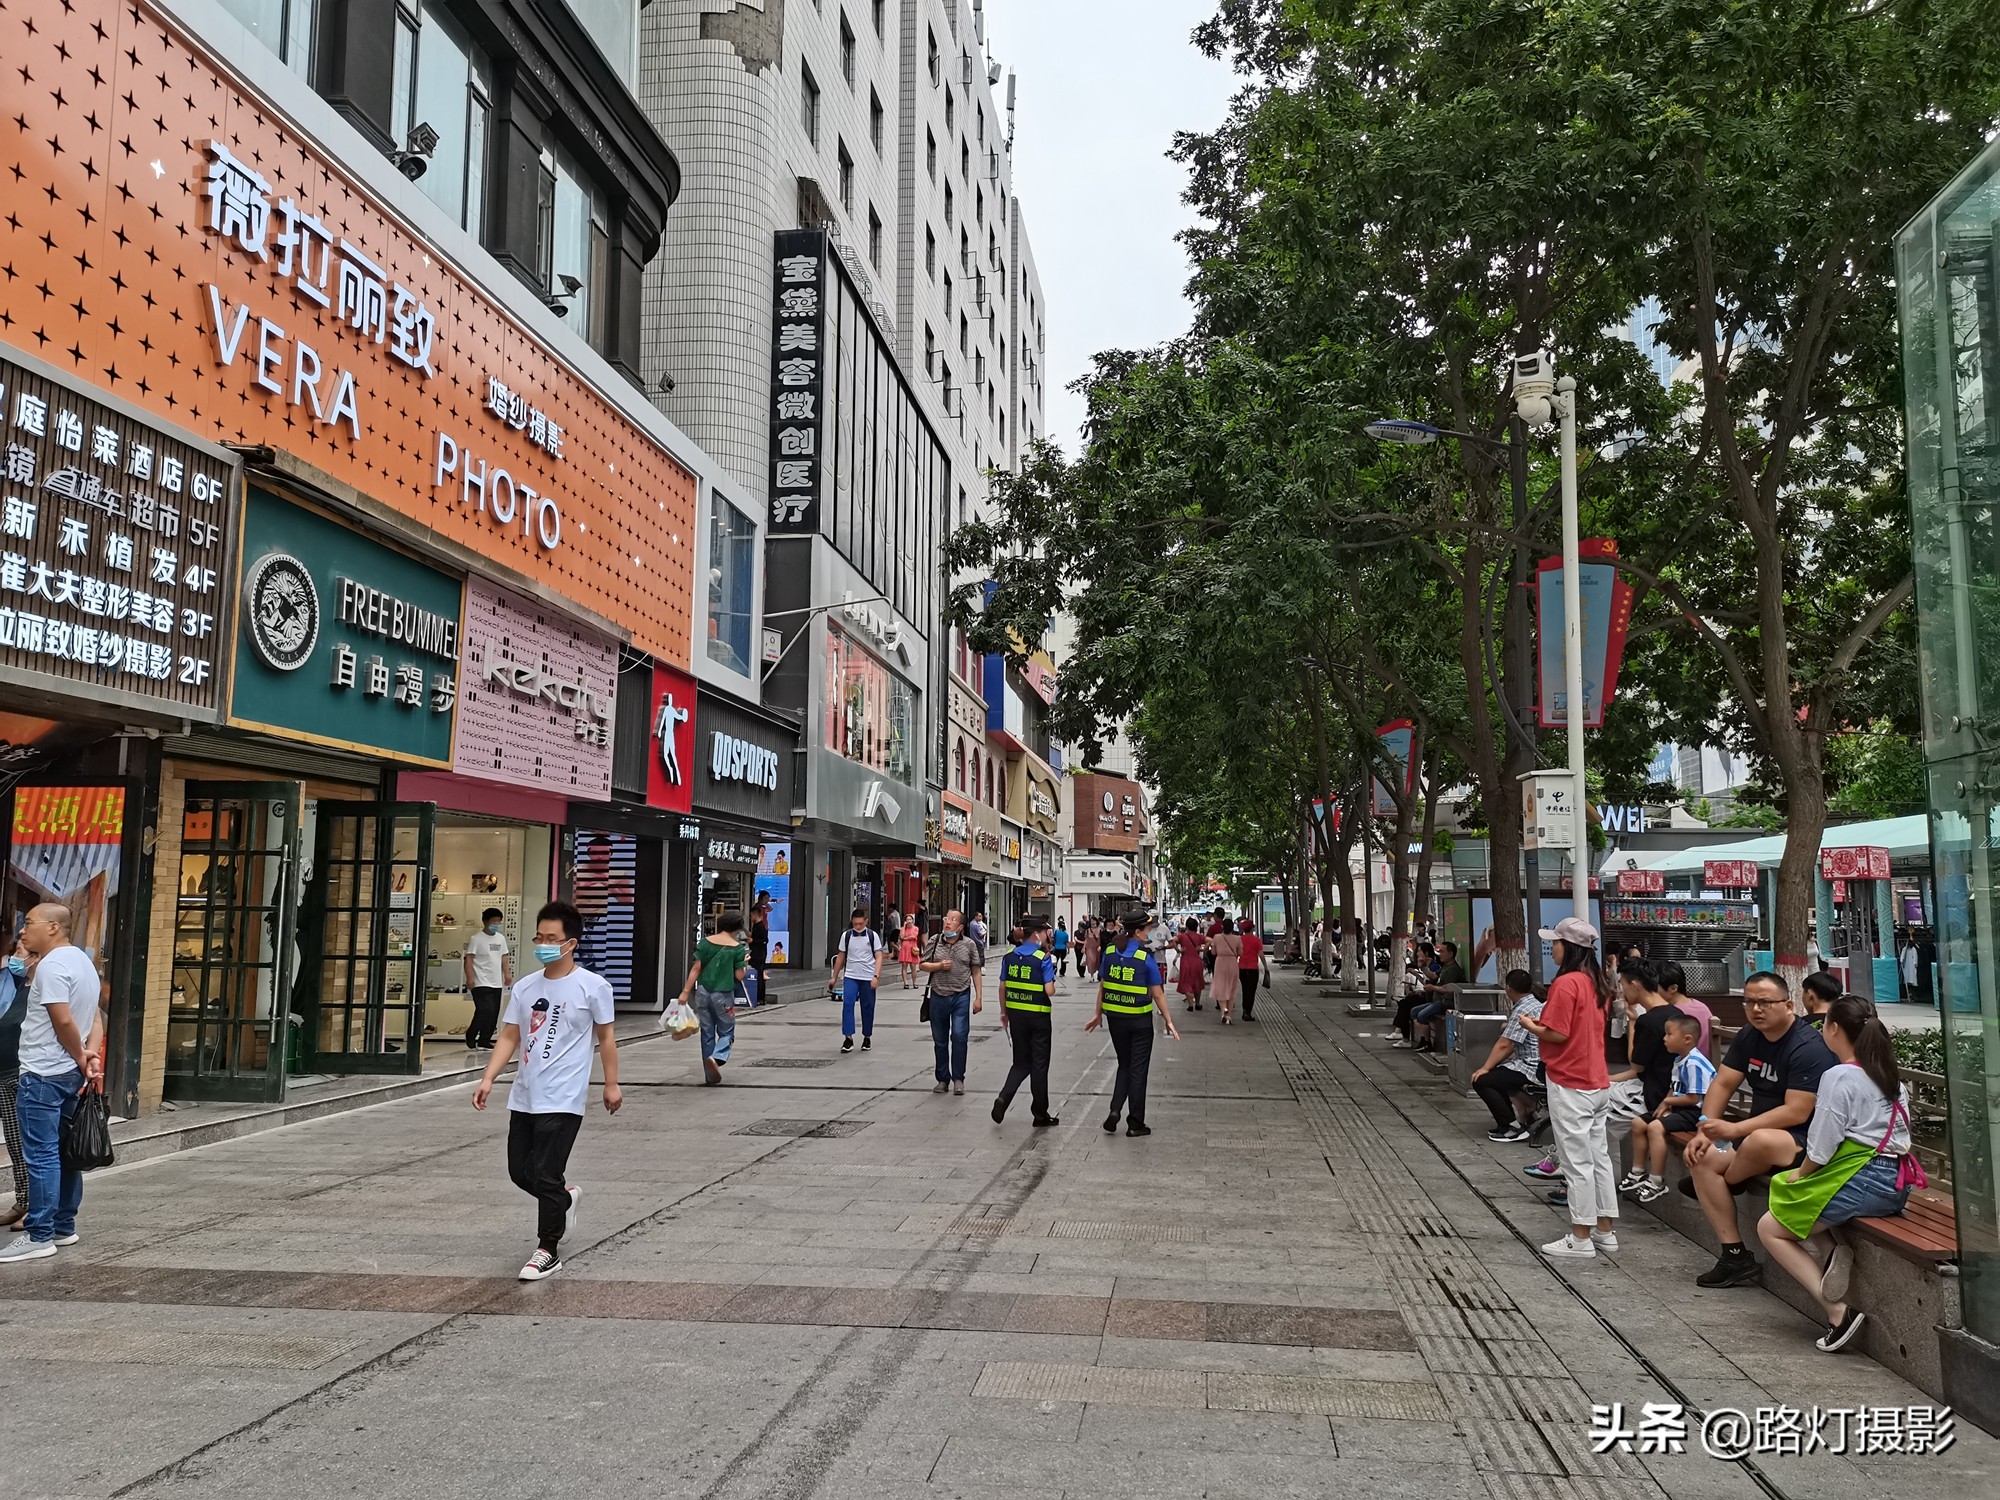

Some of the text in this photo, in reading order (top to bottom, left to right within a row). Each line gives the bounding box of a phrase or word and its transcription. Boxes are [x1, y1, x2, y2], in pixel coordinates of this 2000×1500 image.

[204, 140, 434, 380] 薇拉丽致
[204, 283, 361, 440] VERA
[773, 254, 818, 523] 宝黛美容微创医疗
[0, 383, 222, 505] 庭怡莱酒店 6F
[485, 375, 564, 460] 婚纱摄影
[434, 431, 561, 549] PHOTO
[189, 519, 219, 551] 5F
[0, 550, 213, 640] 崔大夫整形美容 3F
[183, 564, 216, 595] 4F
[177, 655, 210, 686] 2F
[266, 641, 300, 661] SHOES
[336, 643, 456, 713] 自由漫步
[711, 731, 778, 792] QDSPORTS
[1621, 907, 1688, 921] 禁止攀爬
[1008, 964, 1032, 980] 城管
[1108, 964, 1135, 982] 城管
[1121, 995, 1136, 1004] GUAN
